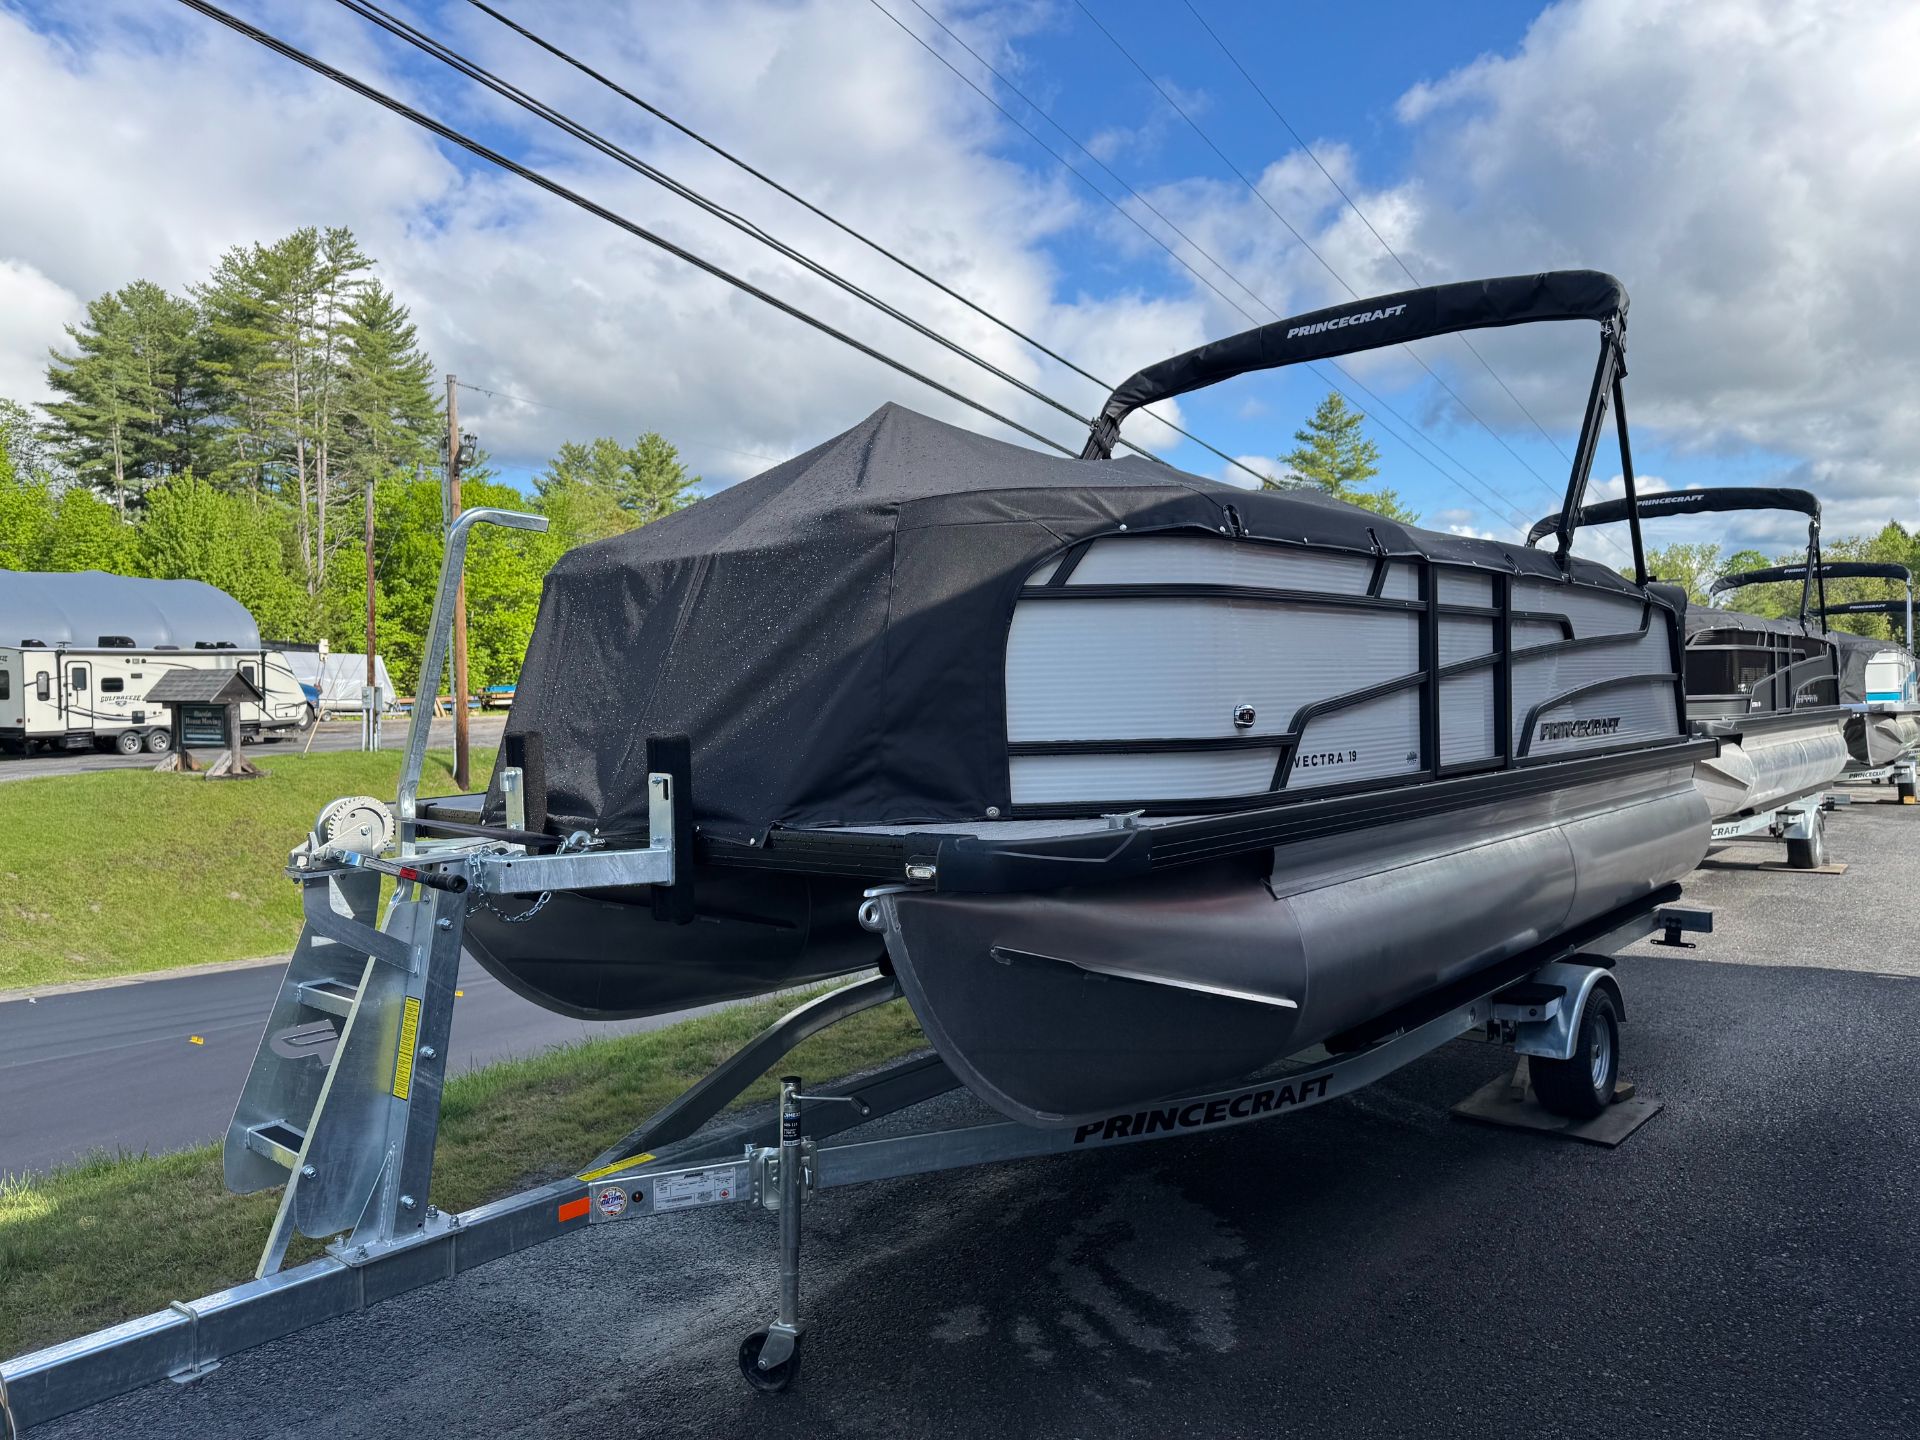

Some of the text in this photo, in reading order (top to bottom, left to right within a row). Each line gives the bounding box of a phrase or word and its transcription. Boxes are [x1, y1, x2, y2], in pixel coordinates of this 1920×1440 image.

[1287, 304, 1406, 339] PRINCECRAFT
[1636, 494, 1704, 507] PRINCECRAFT
[1540, 717, 1620, 741] PRINCECRAFT
[1295, 750, 1357, 768] VECTRA 19
[1073, 1073, 1333, 1144] PRINCECRAFT
